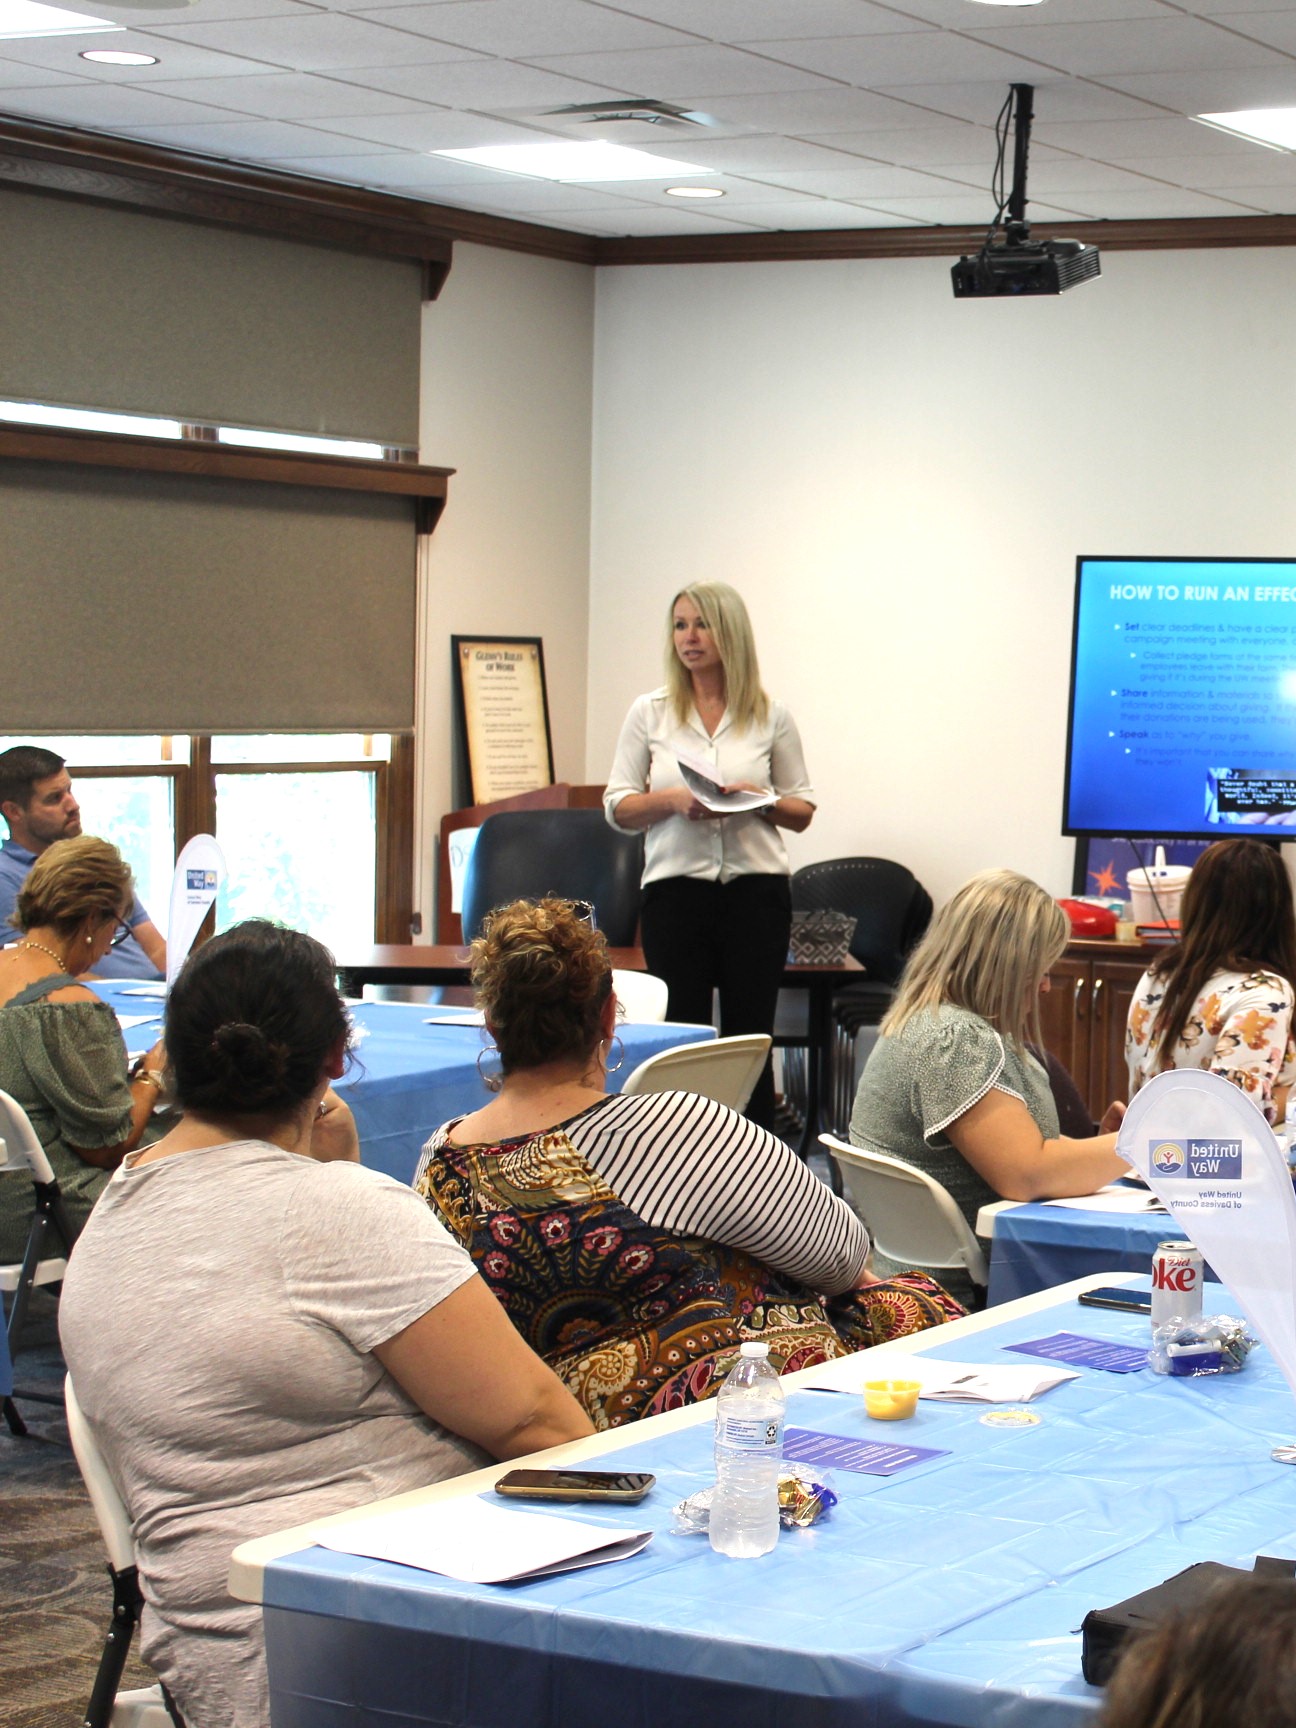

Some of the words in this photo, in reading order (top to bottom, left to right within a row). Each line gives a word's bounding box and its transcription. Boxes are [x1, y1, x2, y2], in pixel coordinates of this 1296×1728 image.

[1110, 585, 1152, 600] HOW
[1157, 585, 1179, 600] TO
[1184, 586, 1218, 601] RUN
[1223, 587, 1249, 602] AN
[1121, 689, 1148, 697] Share
[1119, 729, 1149, 739] Speak
